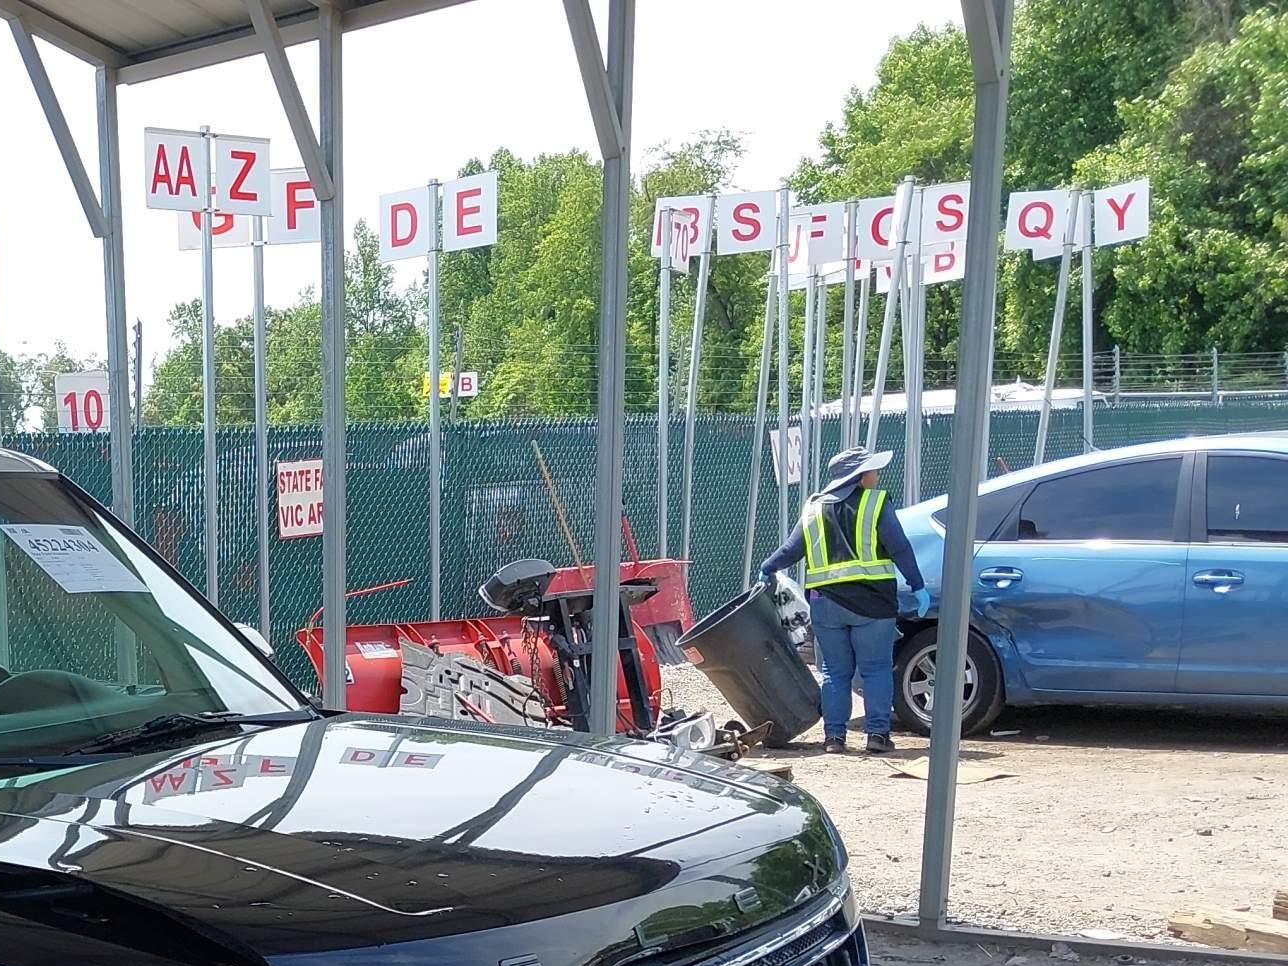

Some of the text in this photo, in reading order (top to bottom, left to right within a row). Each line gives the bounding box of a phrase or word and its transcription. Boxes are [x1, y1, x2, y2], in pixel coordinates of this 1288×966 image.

[152, 144, 197, 198] AA
[229, 150, 258, 202] Z
[286, 181, 315, 230] F
[391, 203, 418, 247] D
[456, 189, 482, 236] E
[732, 202, 761, 242] S
[936, 194, 964, 232] S
[1018, 201, 1054, 240] Q
[1106, 192, 1136, 231] Y
[461, 376, 473, 392] B
[64, 390, 104, 430] 10
[279, 469, 311, 494] STATE
[280, 504, 304, 528] VIC
